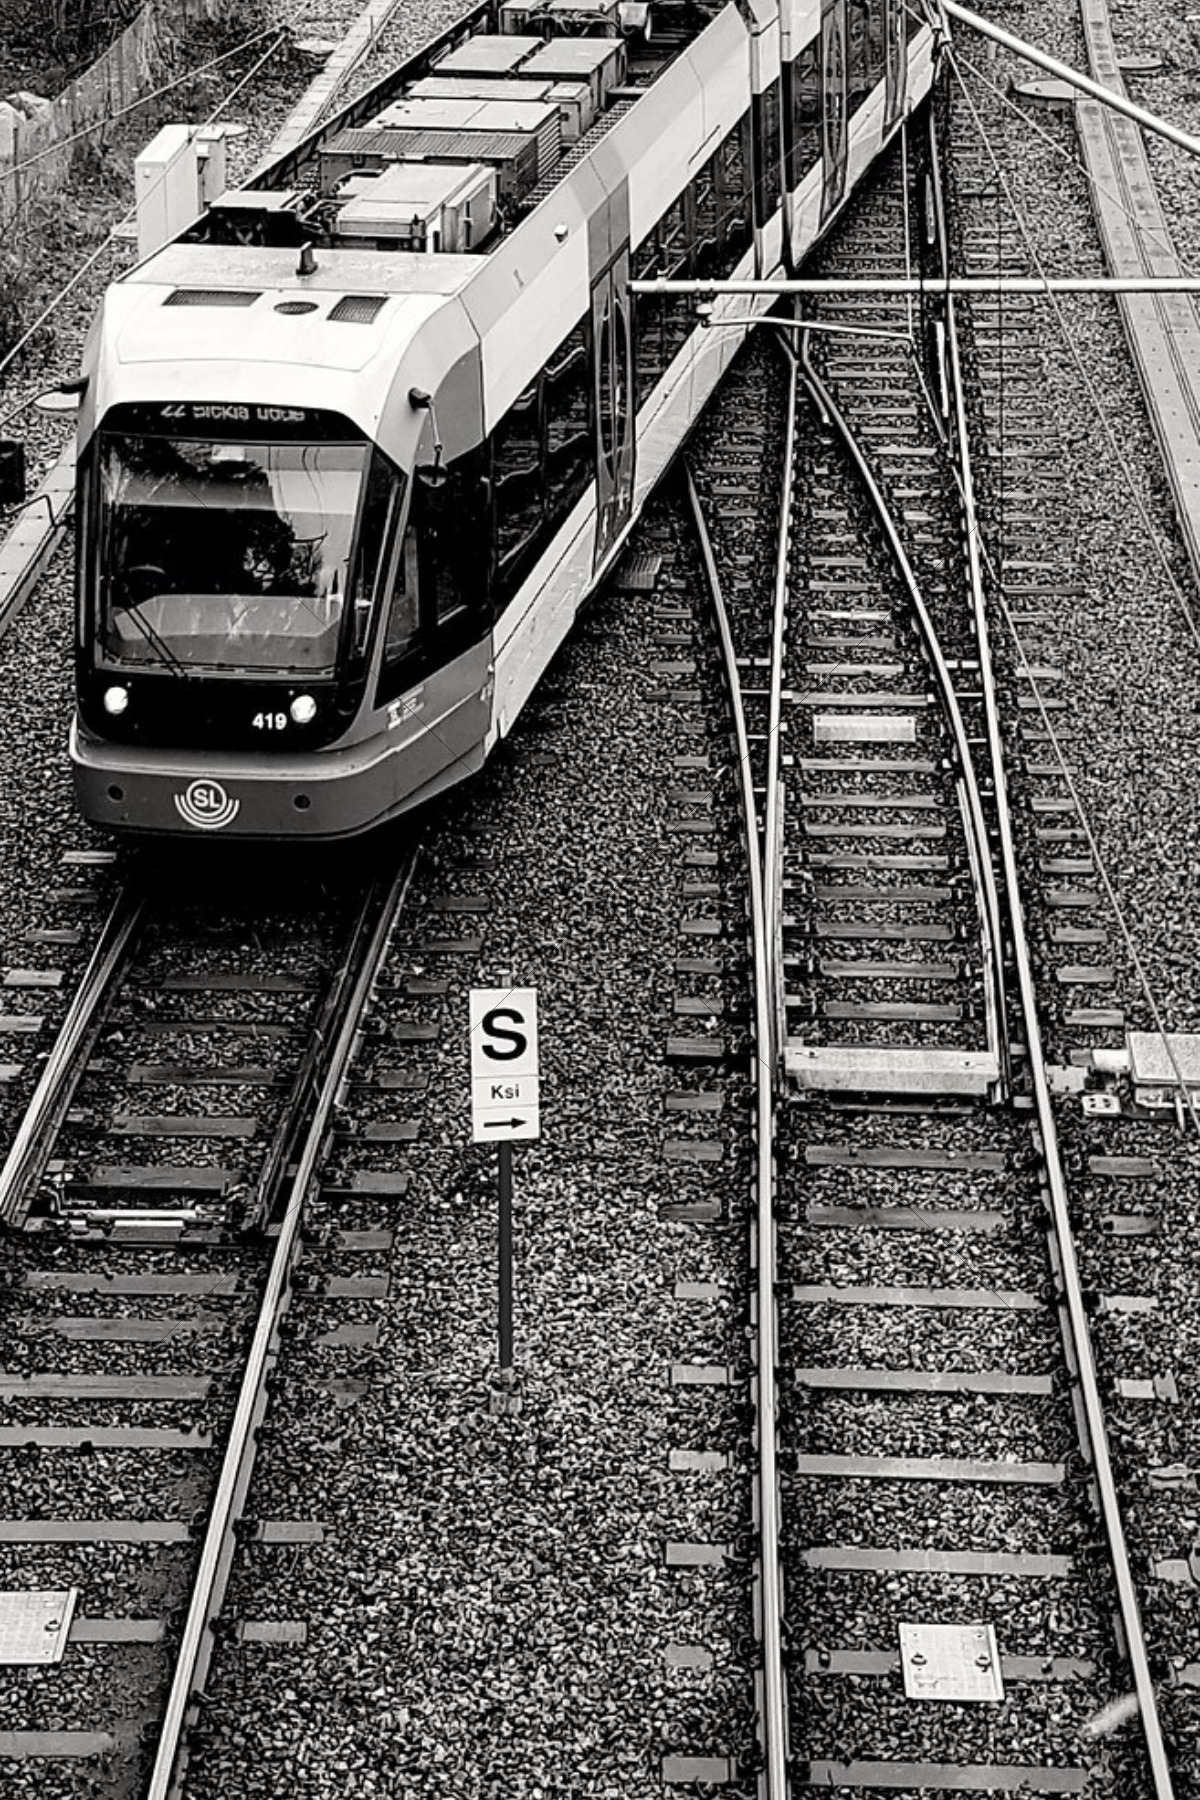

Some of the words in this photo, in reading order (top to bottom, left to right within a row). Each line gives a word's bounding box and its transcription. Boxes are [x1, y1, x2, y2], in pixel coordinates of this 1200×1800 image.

[252, 712, 287, 730] 419
[193, 788, 220, 808] SL
[481, 1008, 528, 1061] S
[490, 1084, 520, 1100] Ksi
